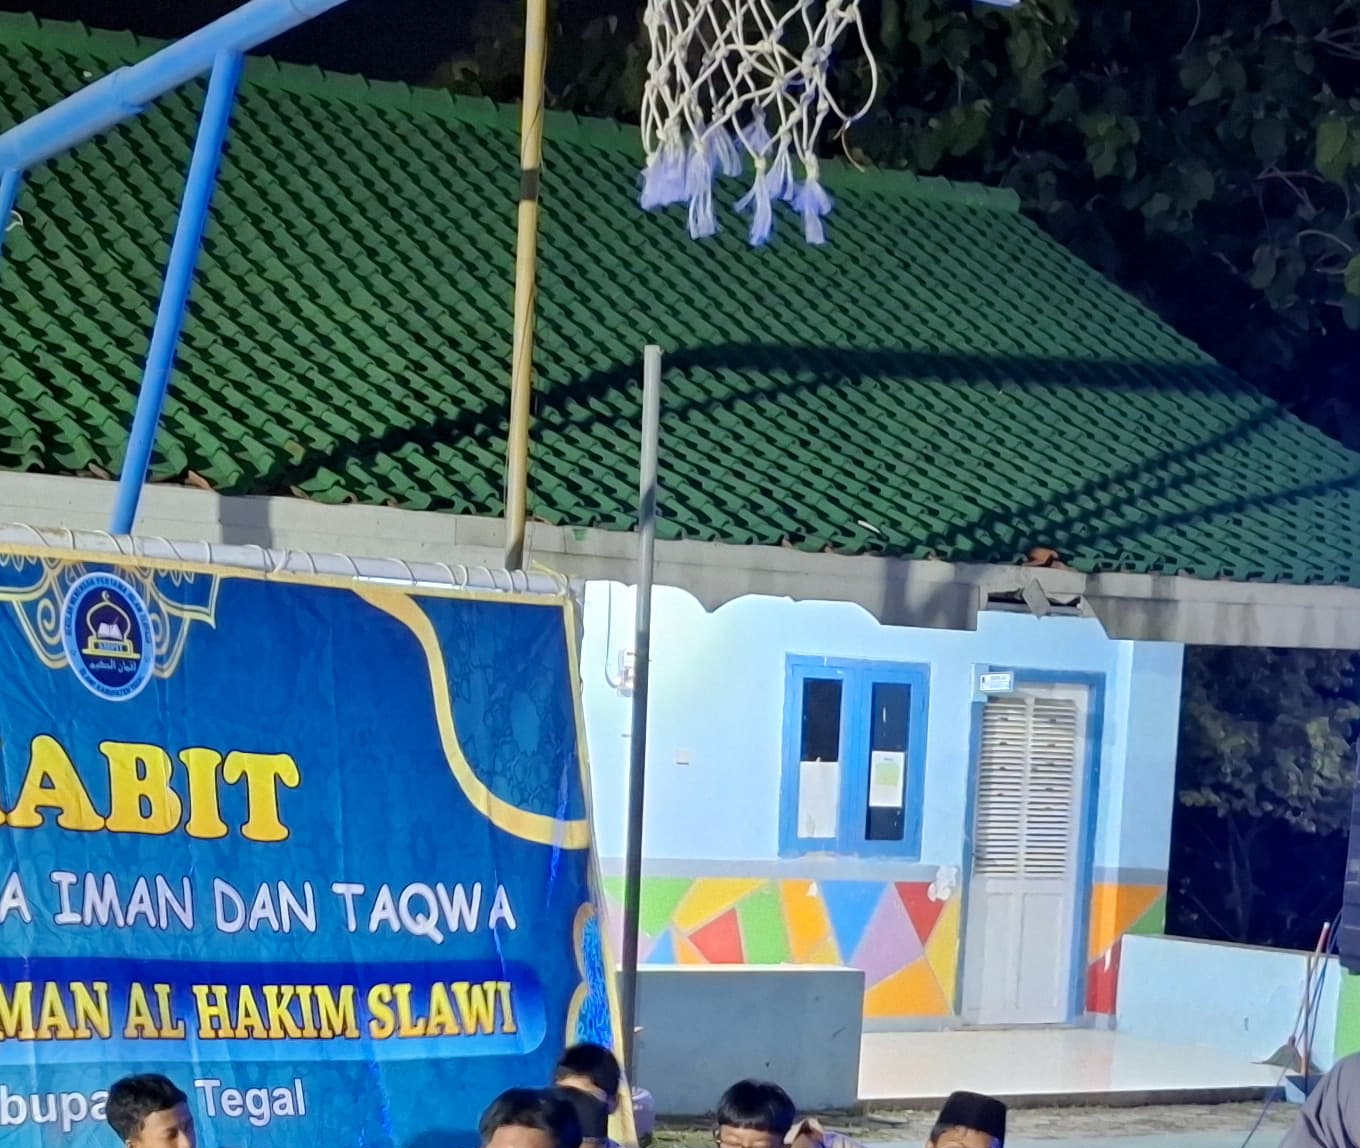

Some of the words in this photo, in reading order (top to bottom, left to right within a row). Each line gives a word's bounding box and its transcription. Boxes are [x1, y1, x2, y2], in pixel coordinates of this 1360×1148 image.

[50, 869, 196, 932] IMAN
[213, 876, 315, 934] DAN
[331, 880, 517, 946] TAQWA
[124, 982, 187, 1042] AL
[193, 982, 359, 1041] HAKIM
[368, 980, 518, 1039] SLAWI
[193, 1078, 307, 1127] Tegal
